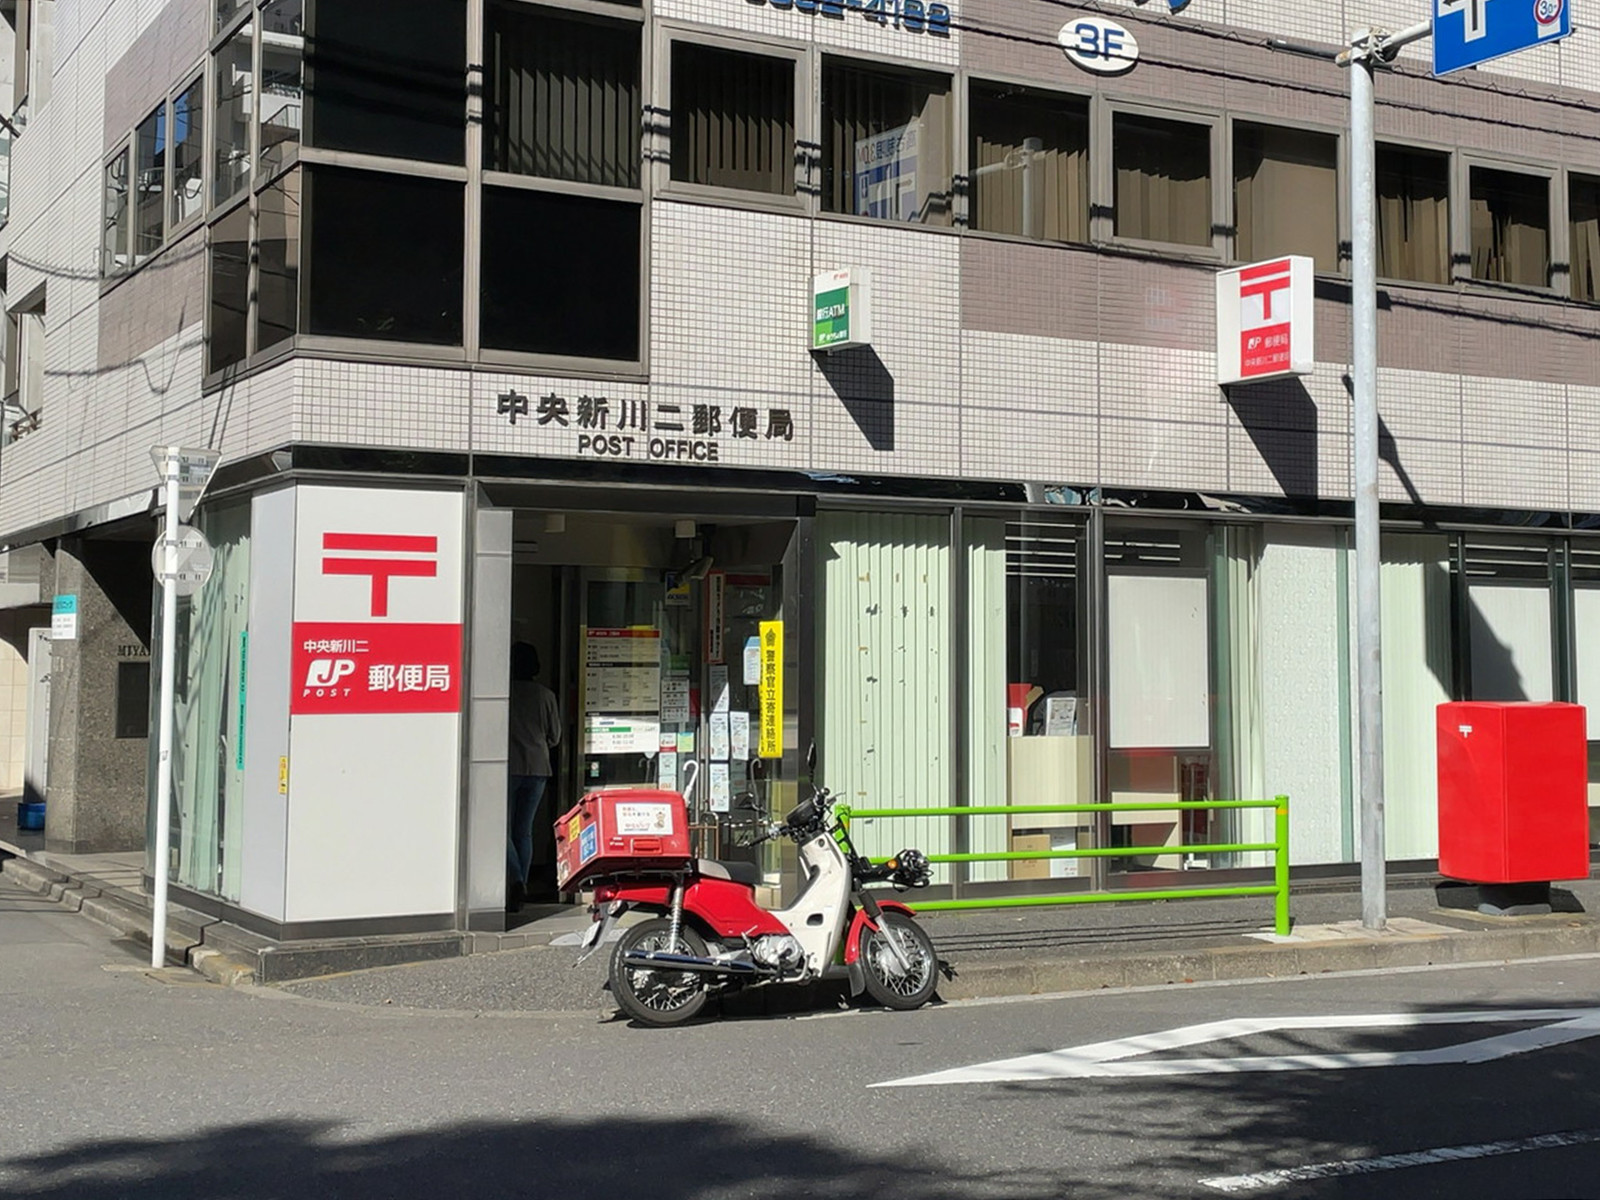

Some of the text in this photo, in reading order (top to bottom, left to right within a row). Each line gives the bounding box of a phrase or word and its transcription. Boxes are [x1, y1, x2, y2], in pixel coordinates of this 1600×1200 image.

[1075, 23, 1125, 60] 3F
[497, 388, 794, 441] 中央新川二郵便局
[578, 434, 718, 461] POST OFFICE
[117, 645, 151, 656] MIYA
[303, 639, 369, 653] 中央新川二
[368, 664, 450, 692] 郵便局
[303, 688, 351, 697] POST
